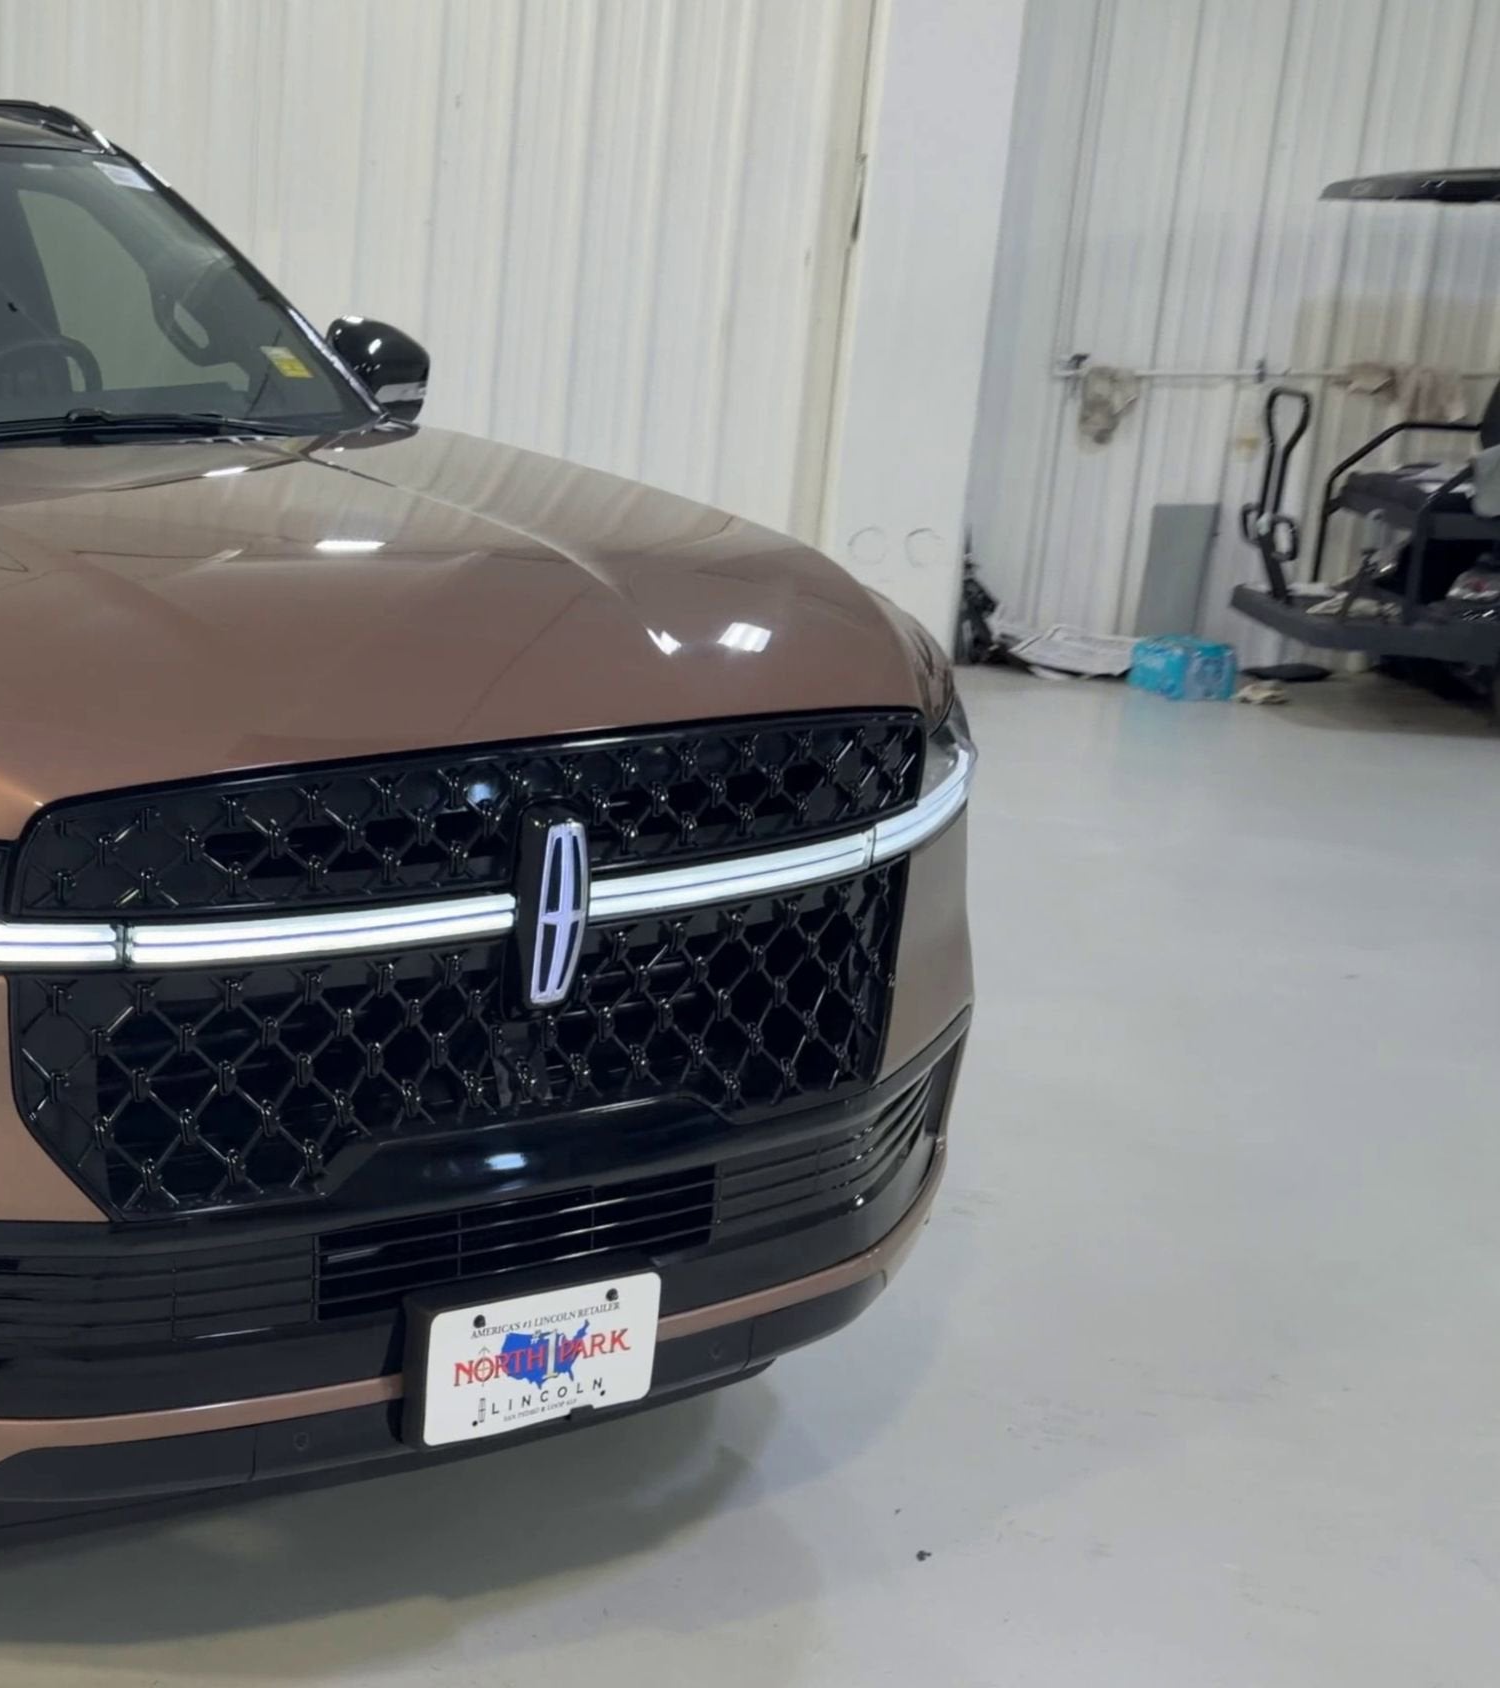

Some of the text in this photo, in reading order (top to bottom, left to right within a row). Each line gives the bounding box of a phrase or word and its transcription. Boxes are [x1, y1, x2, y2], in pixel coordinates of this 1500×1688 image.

[470, 1302, 620, 1339] AMERICA'S #1 LINCOLN RETAILER
[453, 1329, 631, 1387] NORTH PARK
[491, 1378, 603, 1415] LINCOLN
